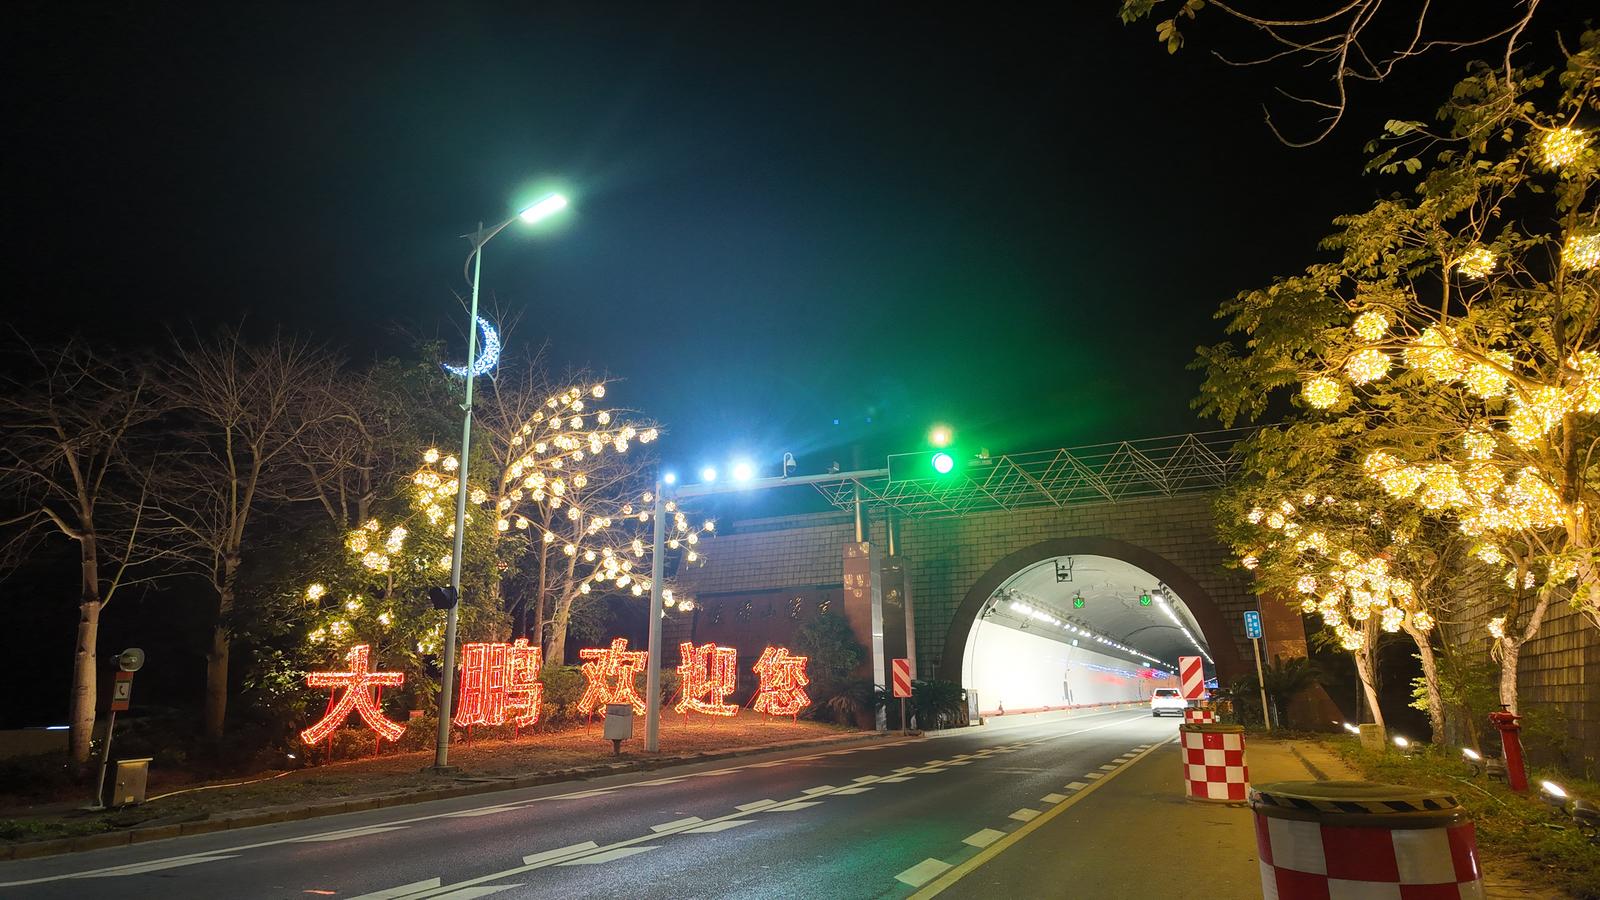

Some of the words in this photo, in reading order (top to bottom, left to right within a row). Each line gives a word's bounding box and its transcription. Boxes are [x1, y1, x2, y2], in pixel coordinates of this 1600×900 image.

[301, 638, 811, 744] 大鹏欢迎您
